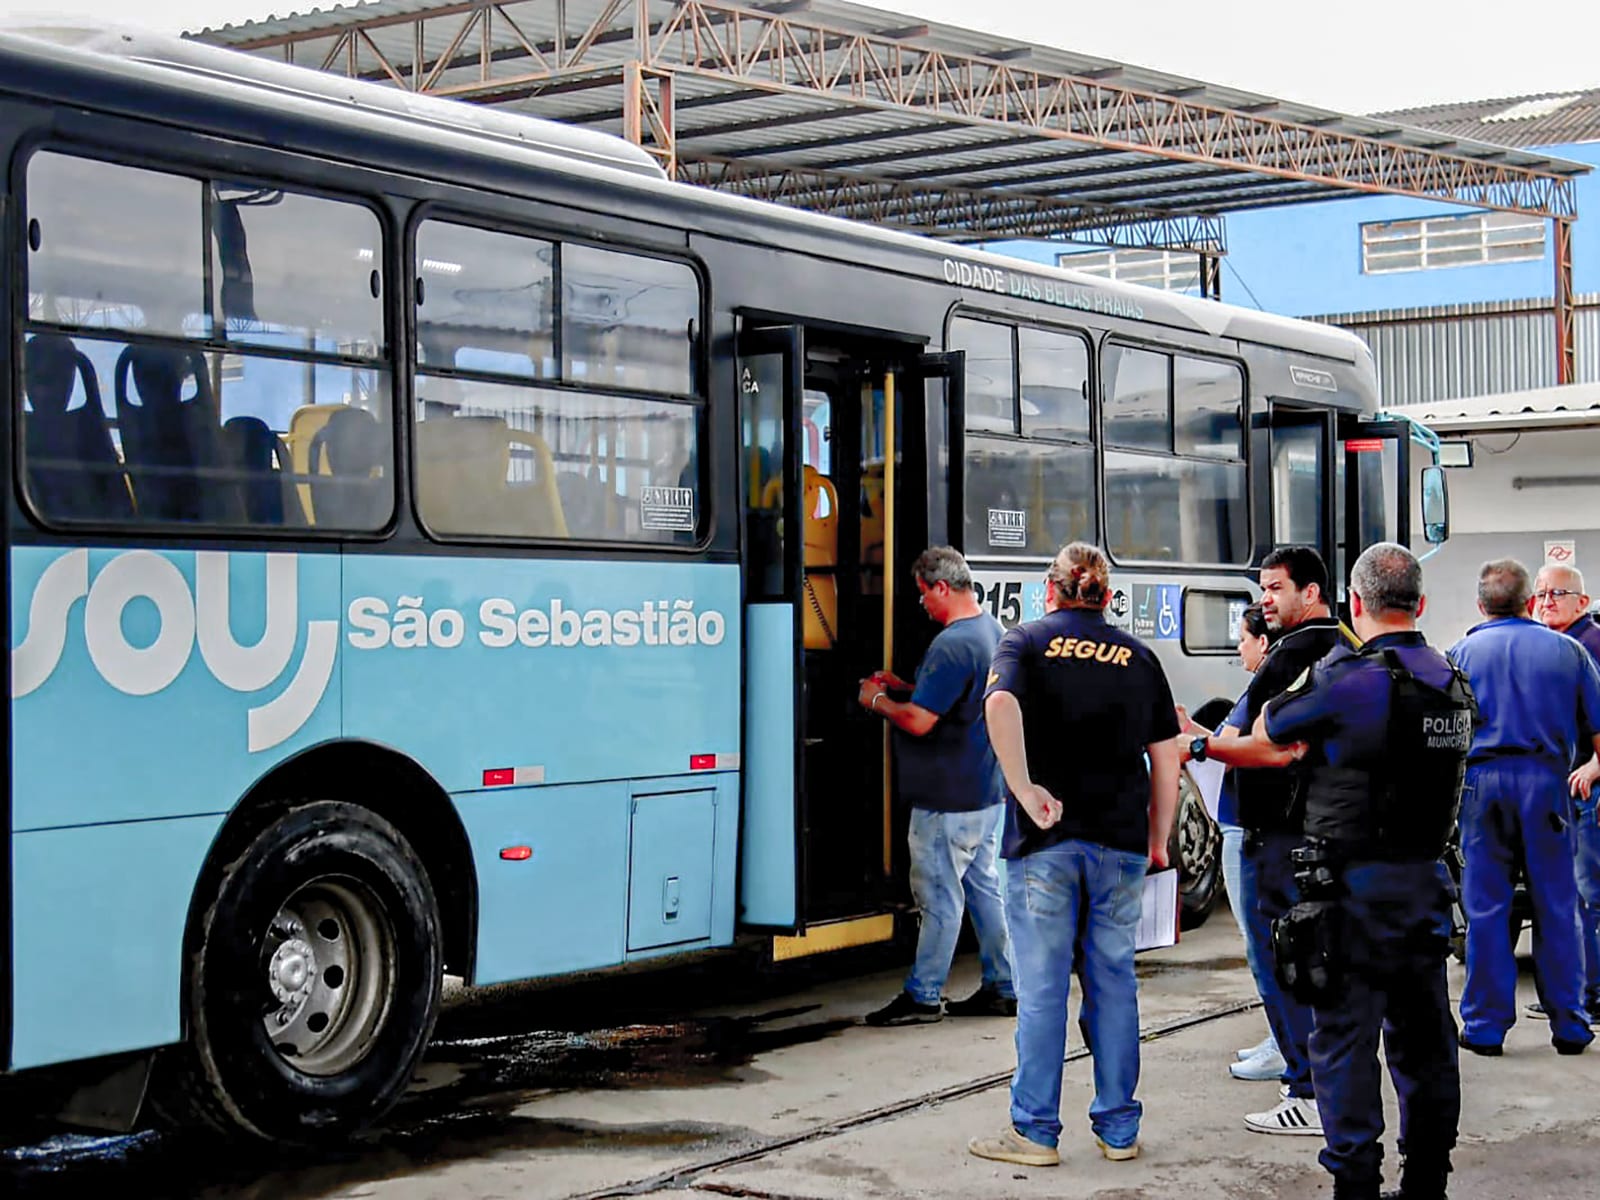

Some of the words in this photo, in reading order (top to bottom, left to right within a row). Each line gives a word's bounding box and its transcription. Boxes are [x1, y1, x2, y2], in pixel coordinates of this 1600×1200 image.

[943, 259, 1005, 293] CIDADE
[1008, 273, 1041, 301] DAS
[1044, 283, 1091, 311] BELAS
[348, 595, 465, 648] São
[479, 598, 724, 647] Sebastião
[973, 582, 1022, 630] 15
[1044, 636, 1132, 667] SEGUR
